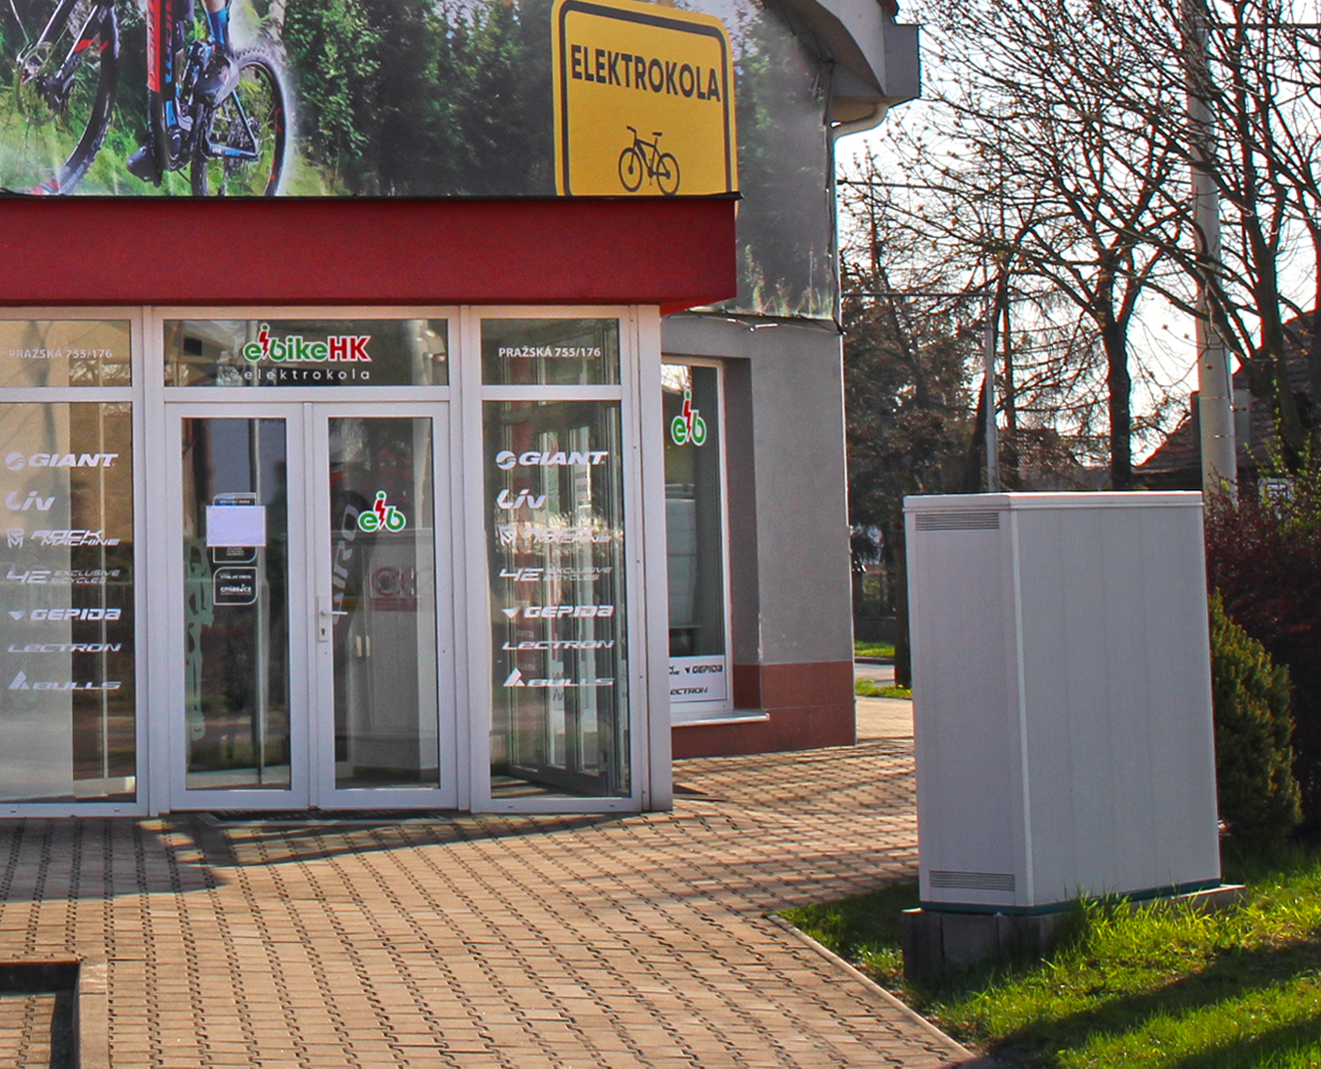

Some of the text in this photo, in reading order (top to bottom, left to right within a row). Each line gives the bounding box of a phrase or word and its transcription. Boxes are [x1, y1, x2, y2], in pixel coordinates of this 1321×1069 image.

[570, 43, 722, 103] ELEKTROKOLA
[66, 348, 113, 359] 755/176
[498, 344, 601, 358] PRAŽSKÁ 755/176
[243, 368, 370, 381] elektrokola
[28, 452, 119, 468] GIANT
[518, 451, 610, 466] GIANT
[30, 529, 106, 540] ROCK
[40, 537, 121, 547] MACHINE
[54, 569, 121, 577] EXCLUSIVE
[32, 681, 122, 690] BULLS
[527, 677, 616, 688] BULLS
[669, 687, 708, 696] ECTRON
